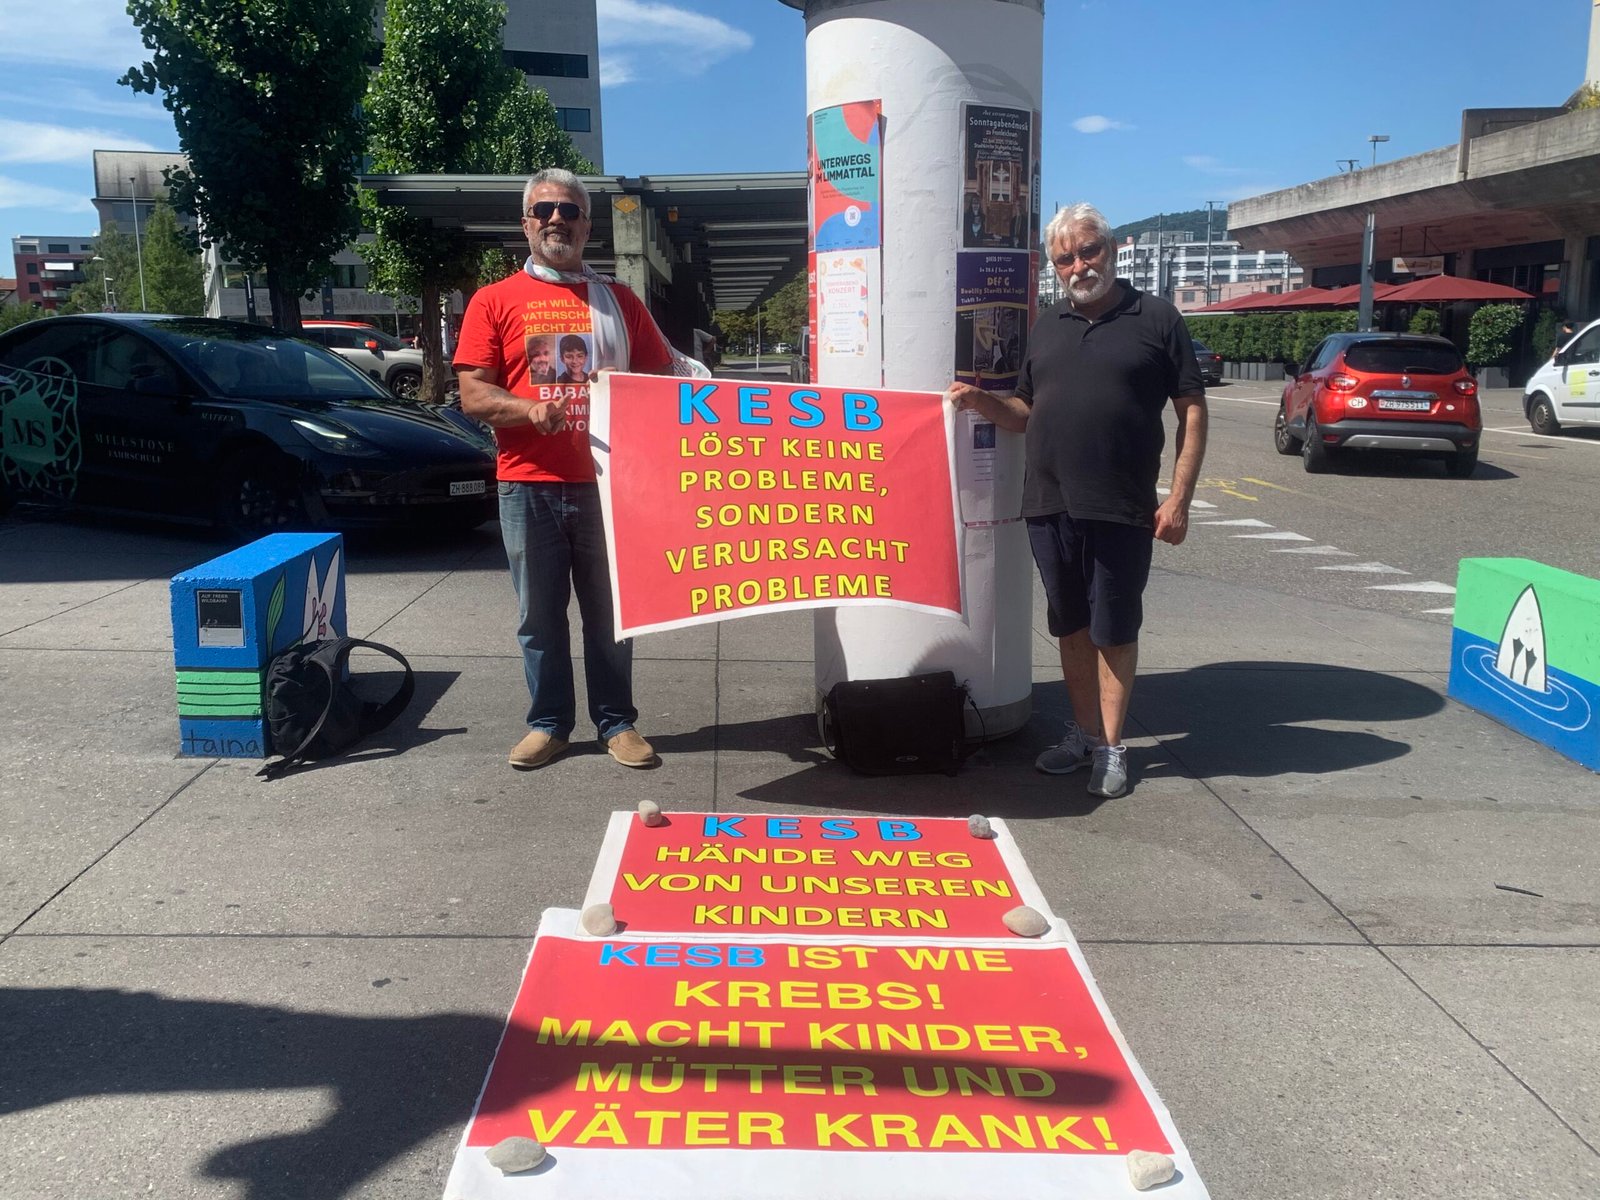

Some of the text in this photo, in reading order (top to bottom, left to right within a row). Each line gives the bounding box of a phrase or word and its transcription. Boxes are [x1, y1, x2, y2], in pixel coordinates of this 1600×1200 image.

[817, 153, 871, 171] UNTERWEGS
[823, 166, 875, 182] LIMMATTAL
[527, 300, 546, 309] ICH
[549, 299, 579, 308] WILL
[525, 323, 566, 334] RECHT
[678, 382, 883, 432] KESB
[1351, 398, 1364, 407] CH
[10, 418, 47, 448] MS
[94, 433, 175, 453] MILESTONE
[680, 432, 884, 461] LÖST KEINE
[679, 469, 888, 497] PROBLEME,
[696, 503, 874, 529] SONDERN
[665, 537, 909, 574] VERURSACHT
[690, 574, 892, 614] PROBLEME
[703, 815, 922, 842] KESB
[656, 842, 973, 869] HÄNDE WEG
[622, 872, 1012, 899] VON UNSEREN
[693, 904, 949, 930] KINDERN
[600, 944, 1012, 972] KESB IST WIE
[674, 981, 945, 1010] KREBS!
[537, 1017, 1087, 1059] MACHT KINDER,
[575, 1056, 1056, 1098] MÜTTER UND
[528, 1103, 1119, 1151] VÄTER KRANK!
